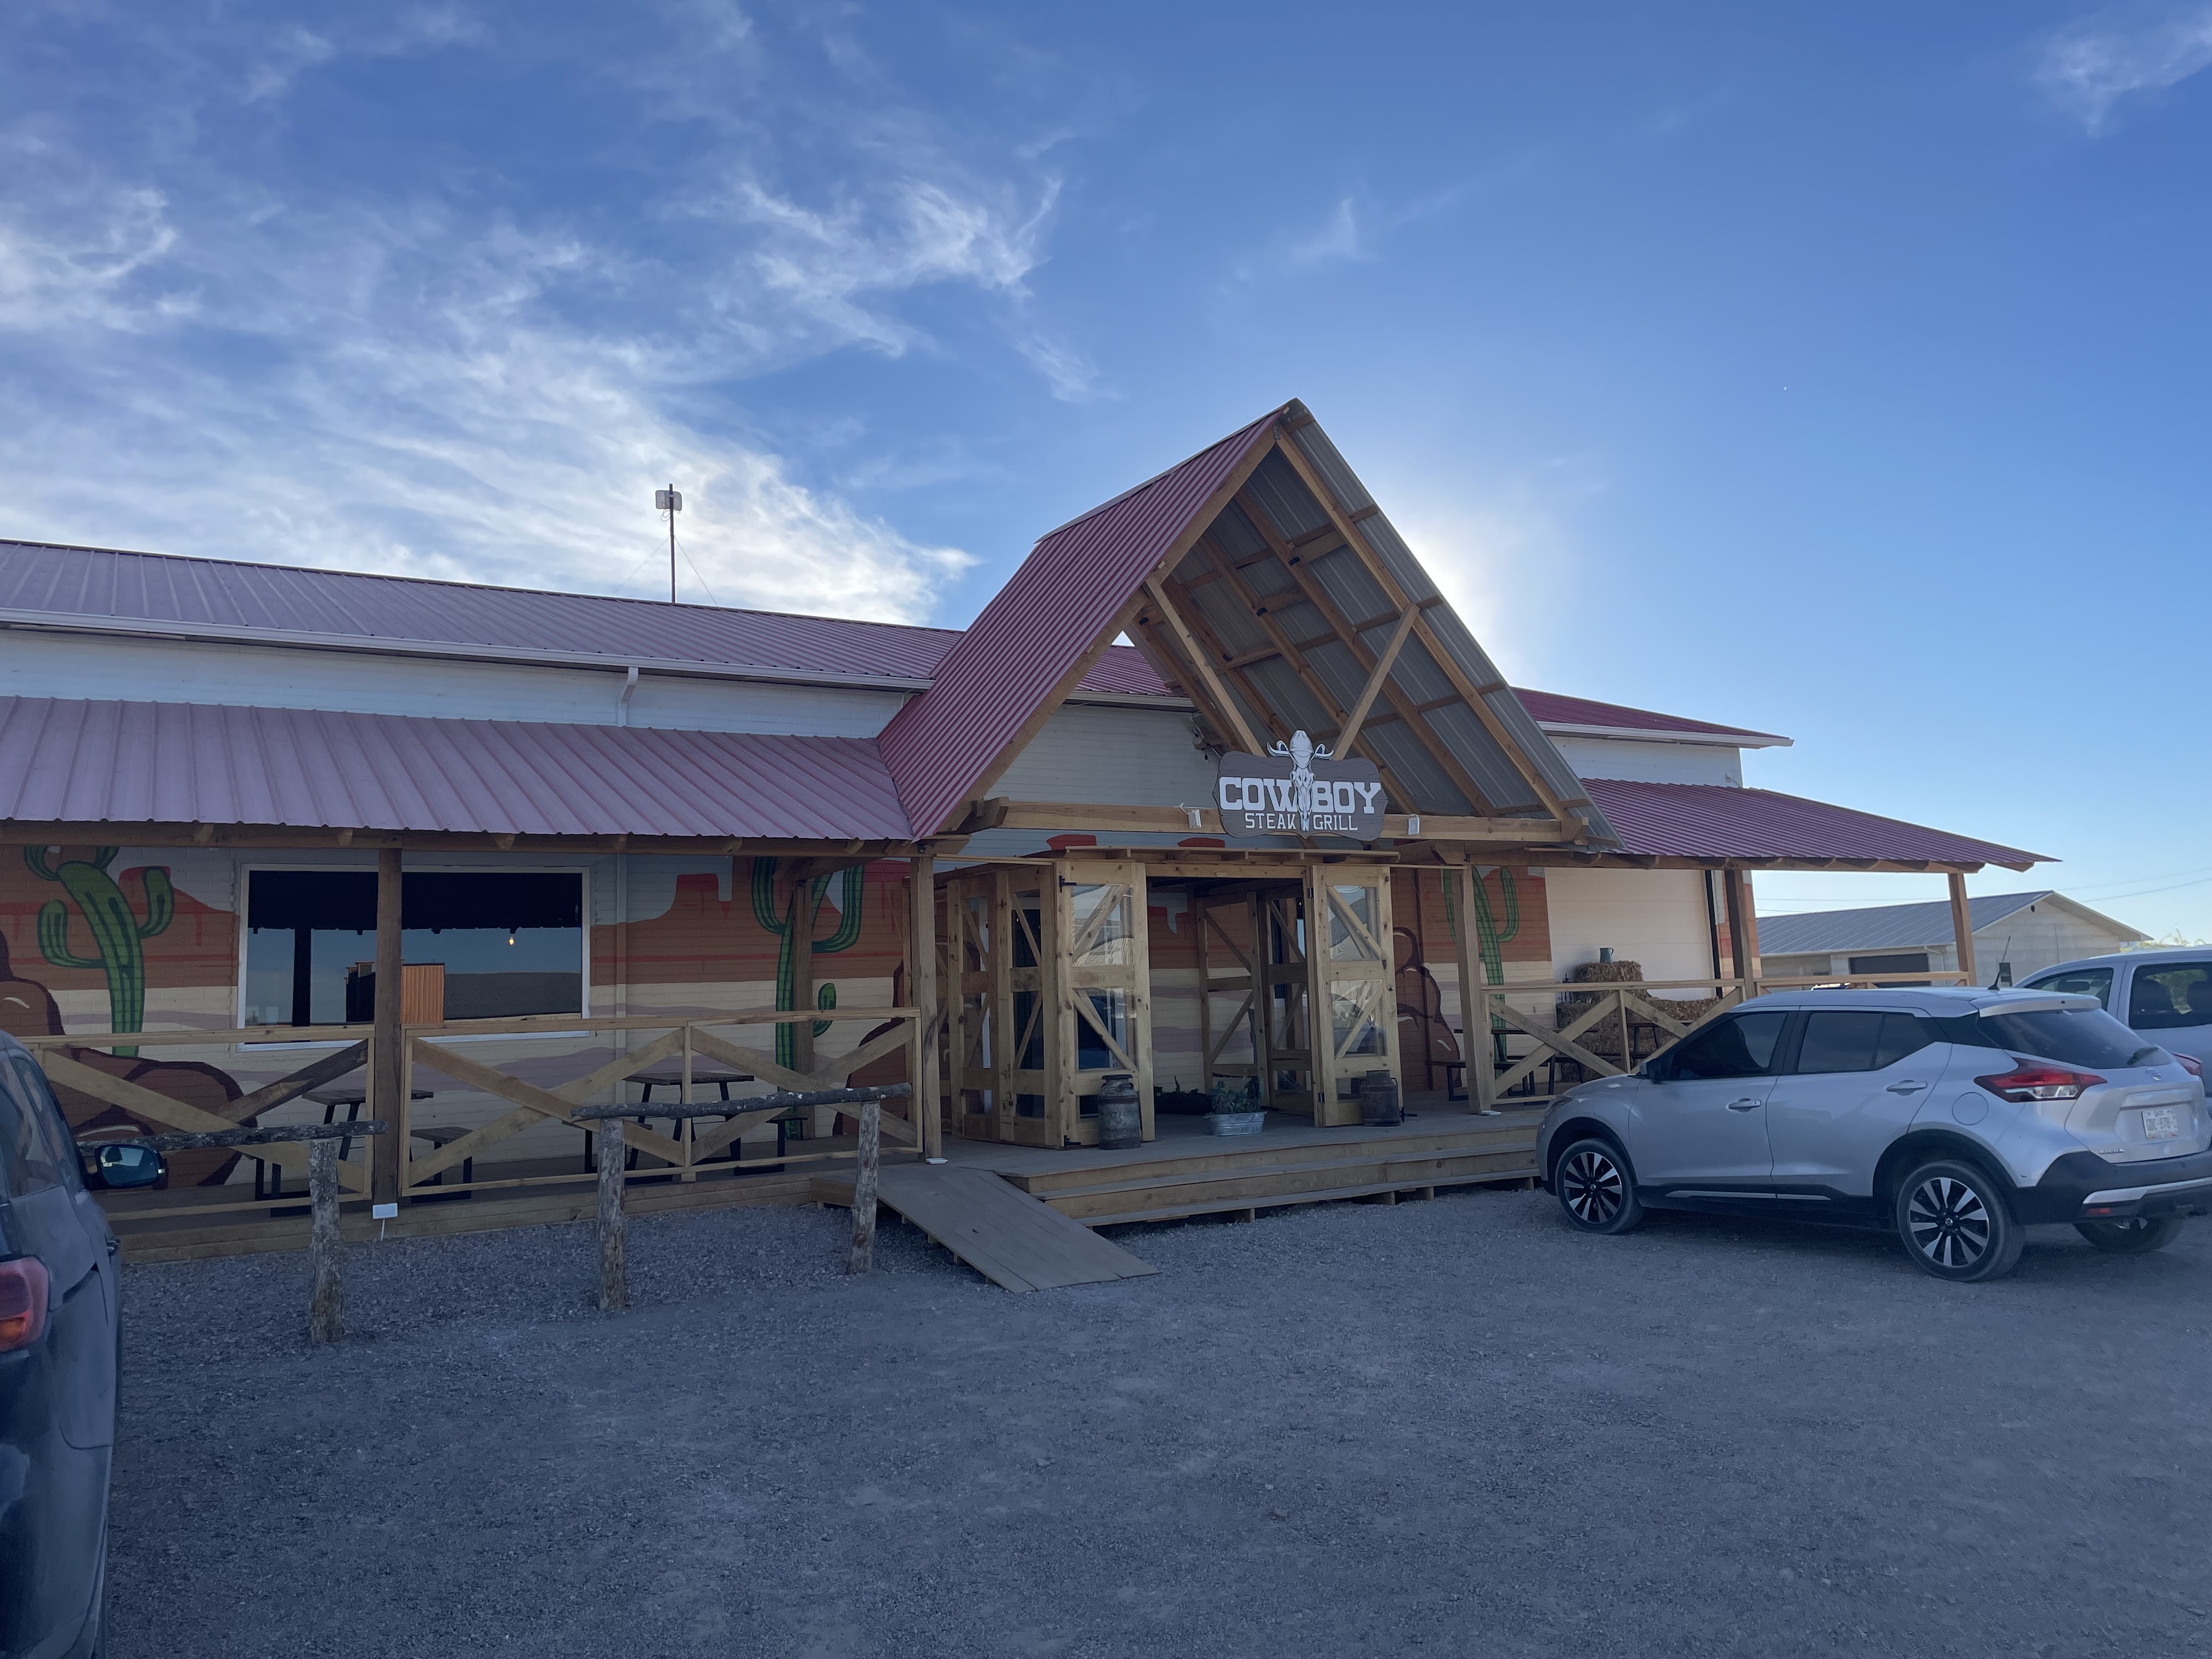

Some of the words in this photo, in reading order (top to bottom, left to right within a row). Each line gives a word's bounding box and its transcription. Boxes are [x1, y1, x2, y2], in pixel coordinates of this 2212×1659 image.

[1219, 777, 1381, 814] COWBOY
[1245, 812, 1296, 830] STEAK
[1313, 815, 1358, 831] GRILL
